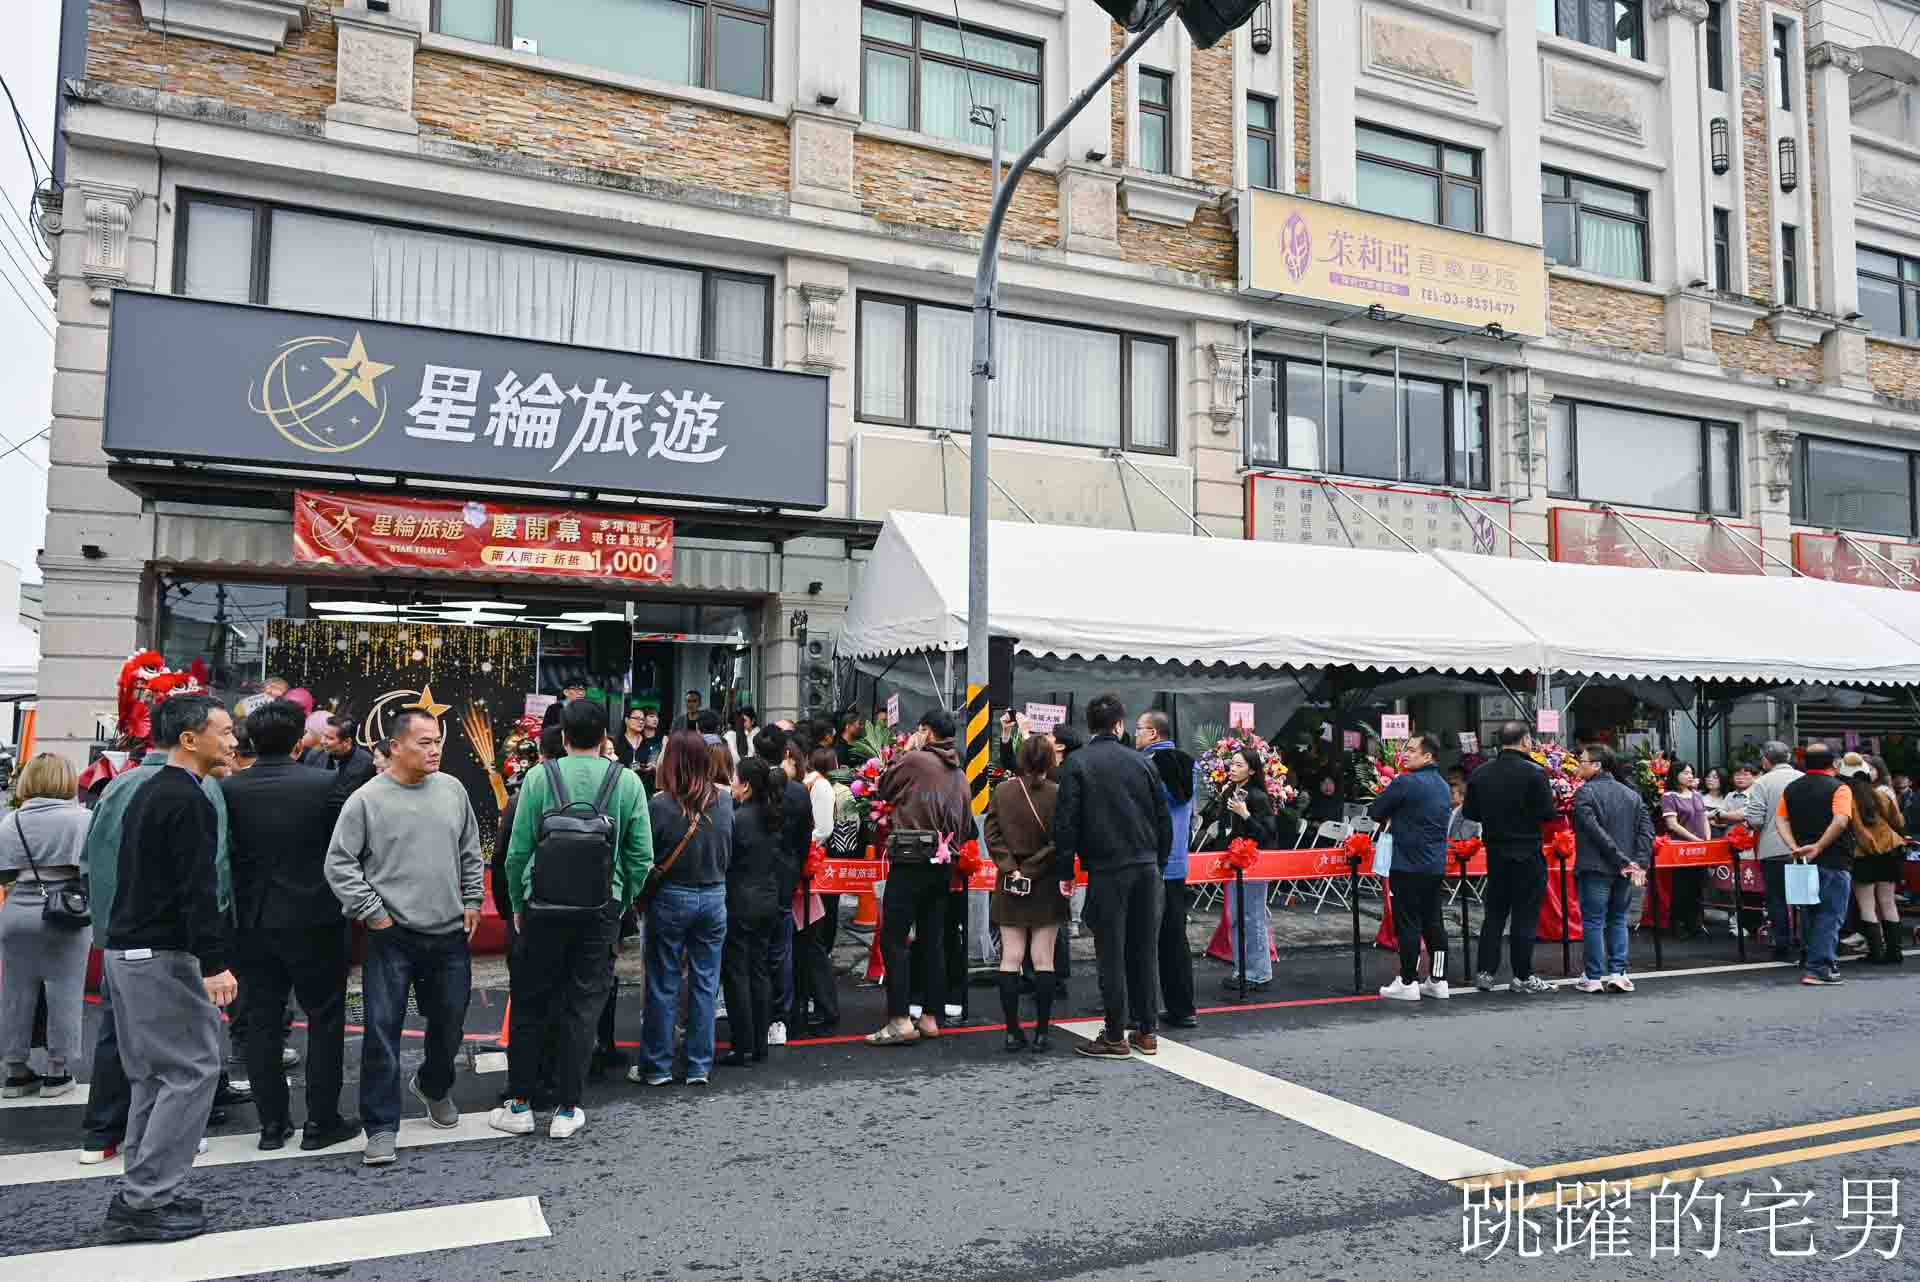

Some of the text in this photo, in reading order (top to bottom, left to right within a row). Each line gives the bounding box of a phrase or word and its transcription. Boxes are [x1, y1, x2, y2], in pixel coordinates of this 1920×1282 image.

[404, 363, 728, 473] 星綸旅遊
[370, 513, 581, 544] 星綸旅遊 慶開幕
[389, 544, 449, 556] STAR TRAVEL
[491, 550, 548, 564] 兩人同行
[592, 549, 657, 576] 1,000
